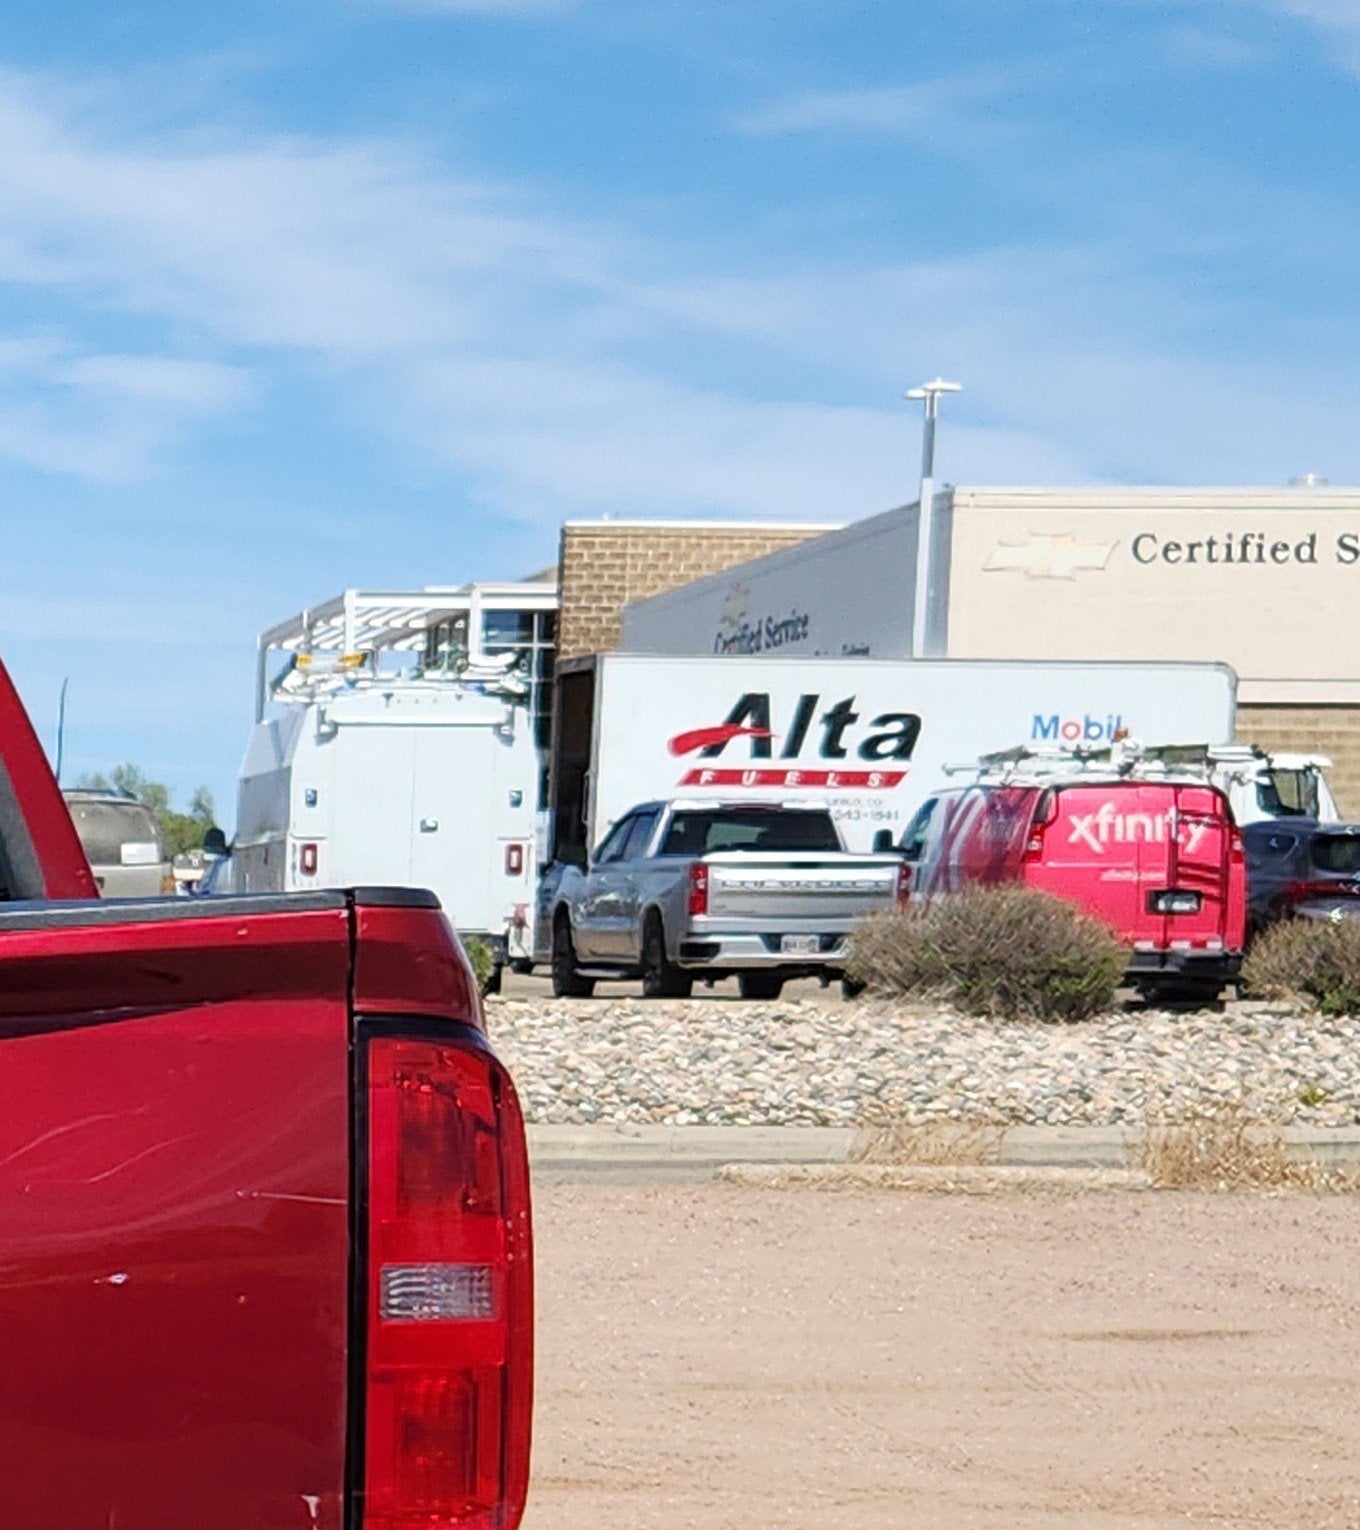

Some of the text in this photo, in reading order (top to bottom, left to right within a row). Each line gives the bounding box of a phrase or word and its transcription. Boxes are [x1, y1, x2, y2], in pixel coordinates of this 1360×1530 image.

[1131, 533, 1318, 565] Certified
[695, 692, 922, 762] Alta
[1031, 714, 1123, 741] Mobil
[698, 770, 883, 787] FUELS
